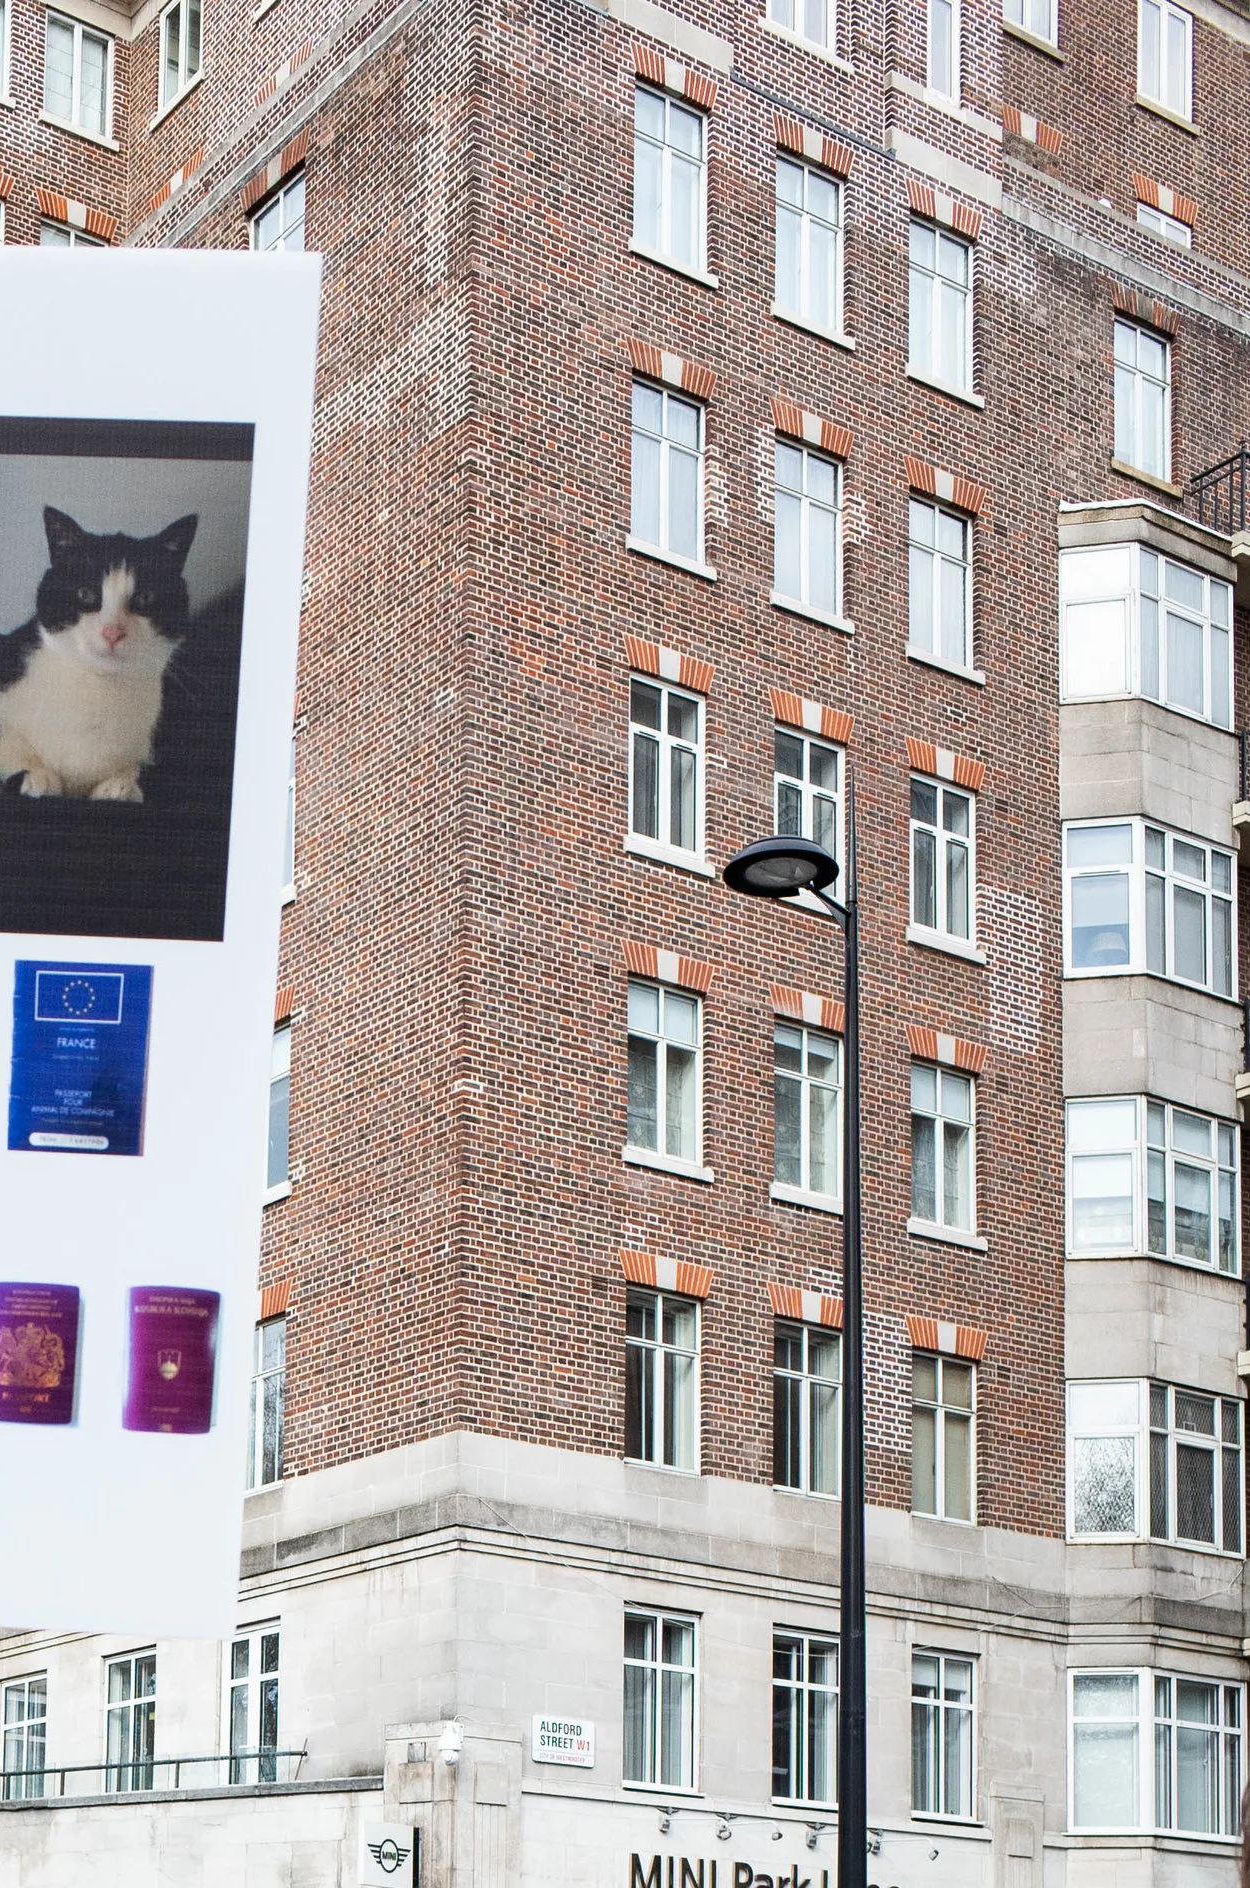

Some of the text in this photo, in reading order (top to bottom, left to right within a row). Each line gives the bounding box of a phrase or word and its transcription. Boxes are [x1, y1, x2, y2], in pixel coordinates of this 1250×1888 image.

[56, 1037, 96, 1050] FRANCE
[540, 1720, 582, 1737] ALDFORD
[540, 1734, 590, 1751] STREET W1
